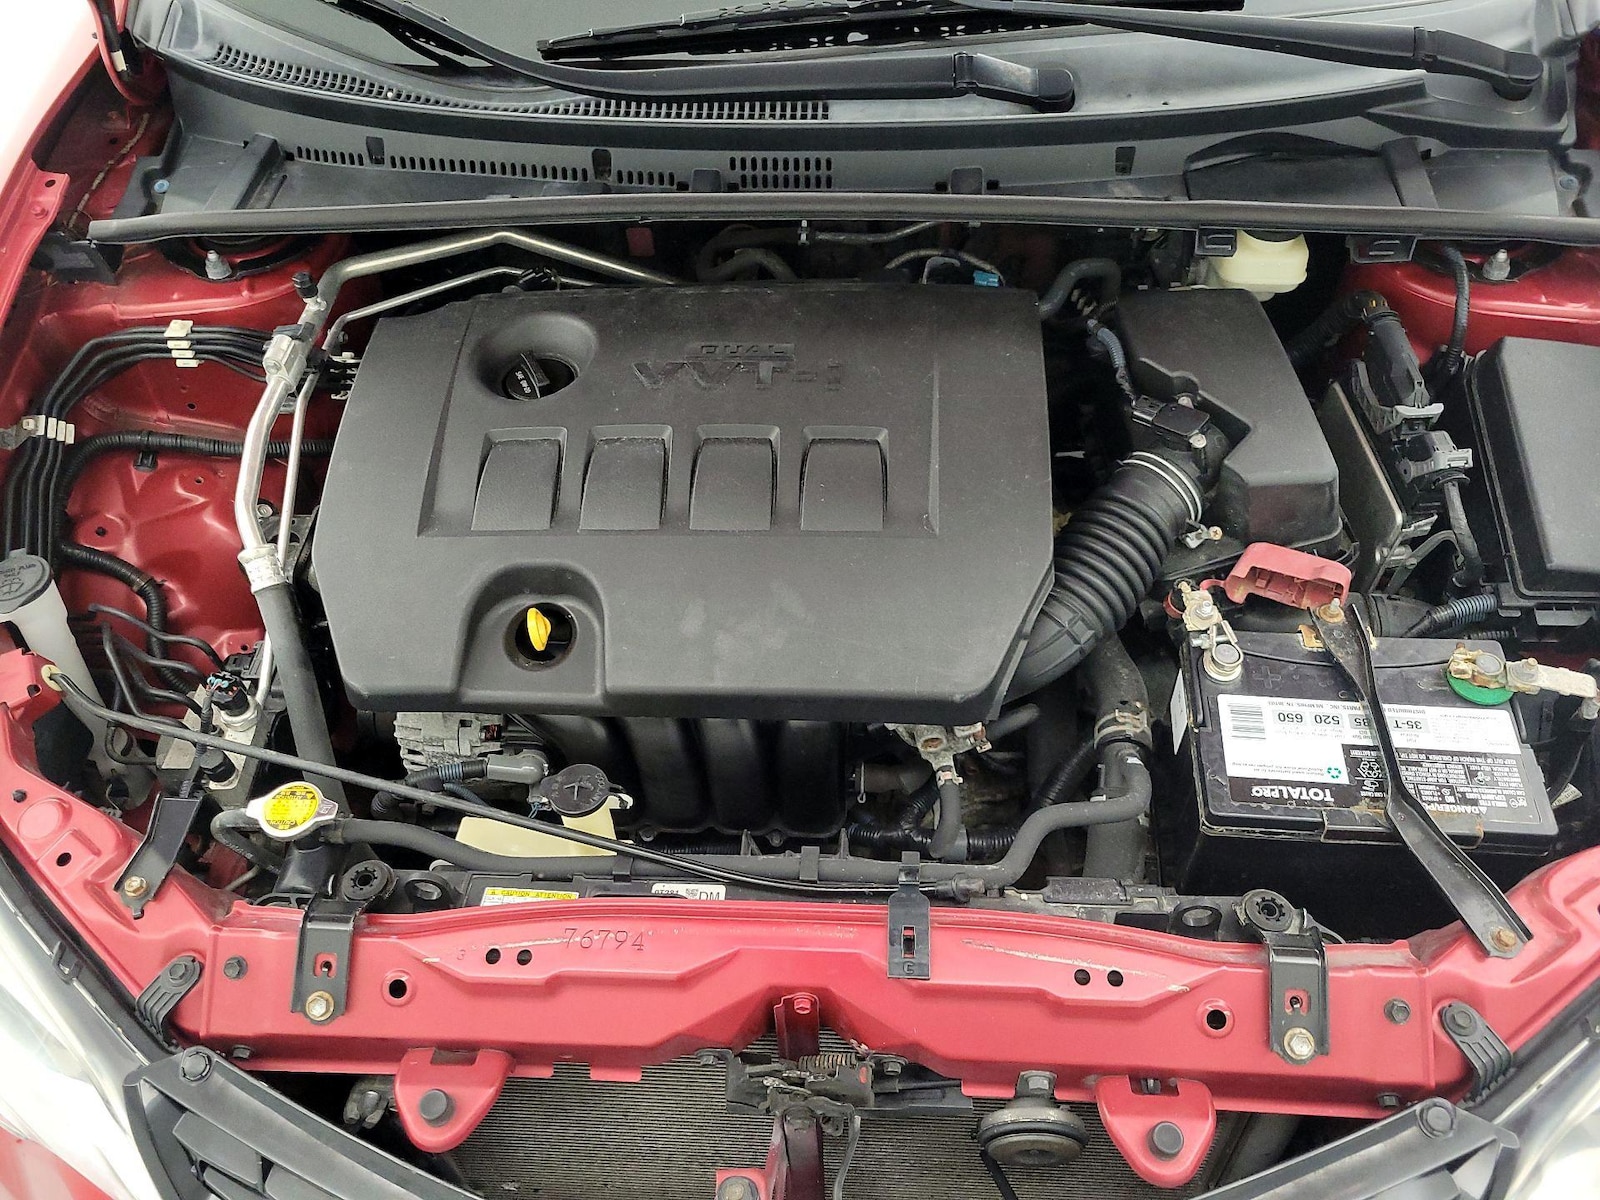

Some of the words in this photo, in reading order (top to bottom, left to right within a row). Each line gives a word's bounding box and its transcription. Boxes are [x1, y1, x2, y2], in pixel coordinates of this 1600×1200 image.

[1277, 712, 1304, 723] 650
[1313, 715, 1340, 725] 520
[1391, 719, 1423, 730] 35-T
[1251, 783, 1334, 802] TOTALPRO
[563, 927, 646, 951] 76794
